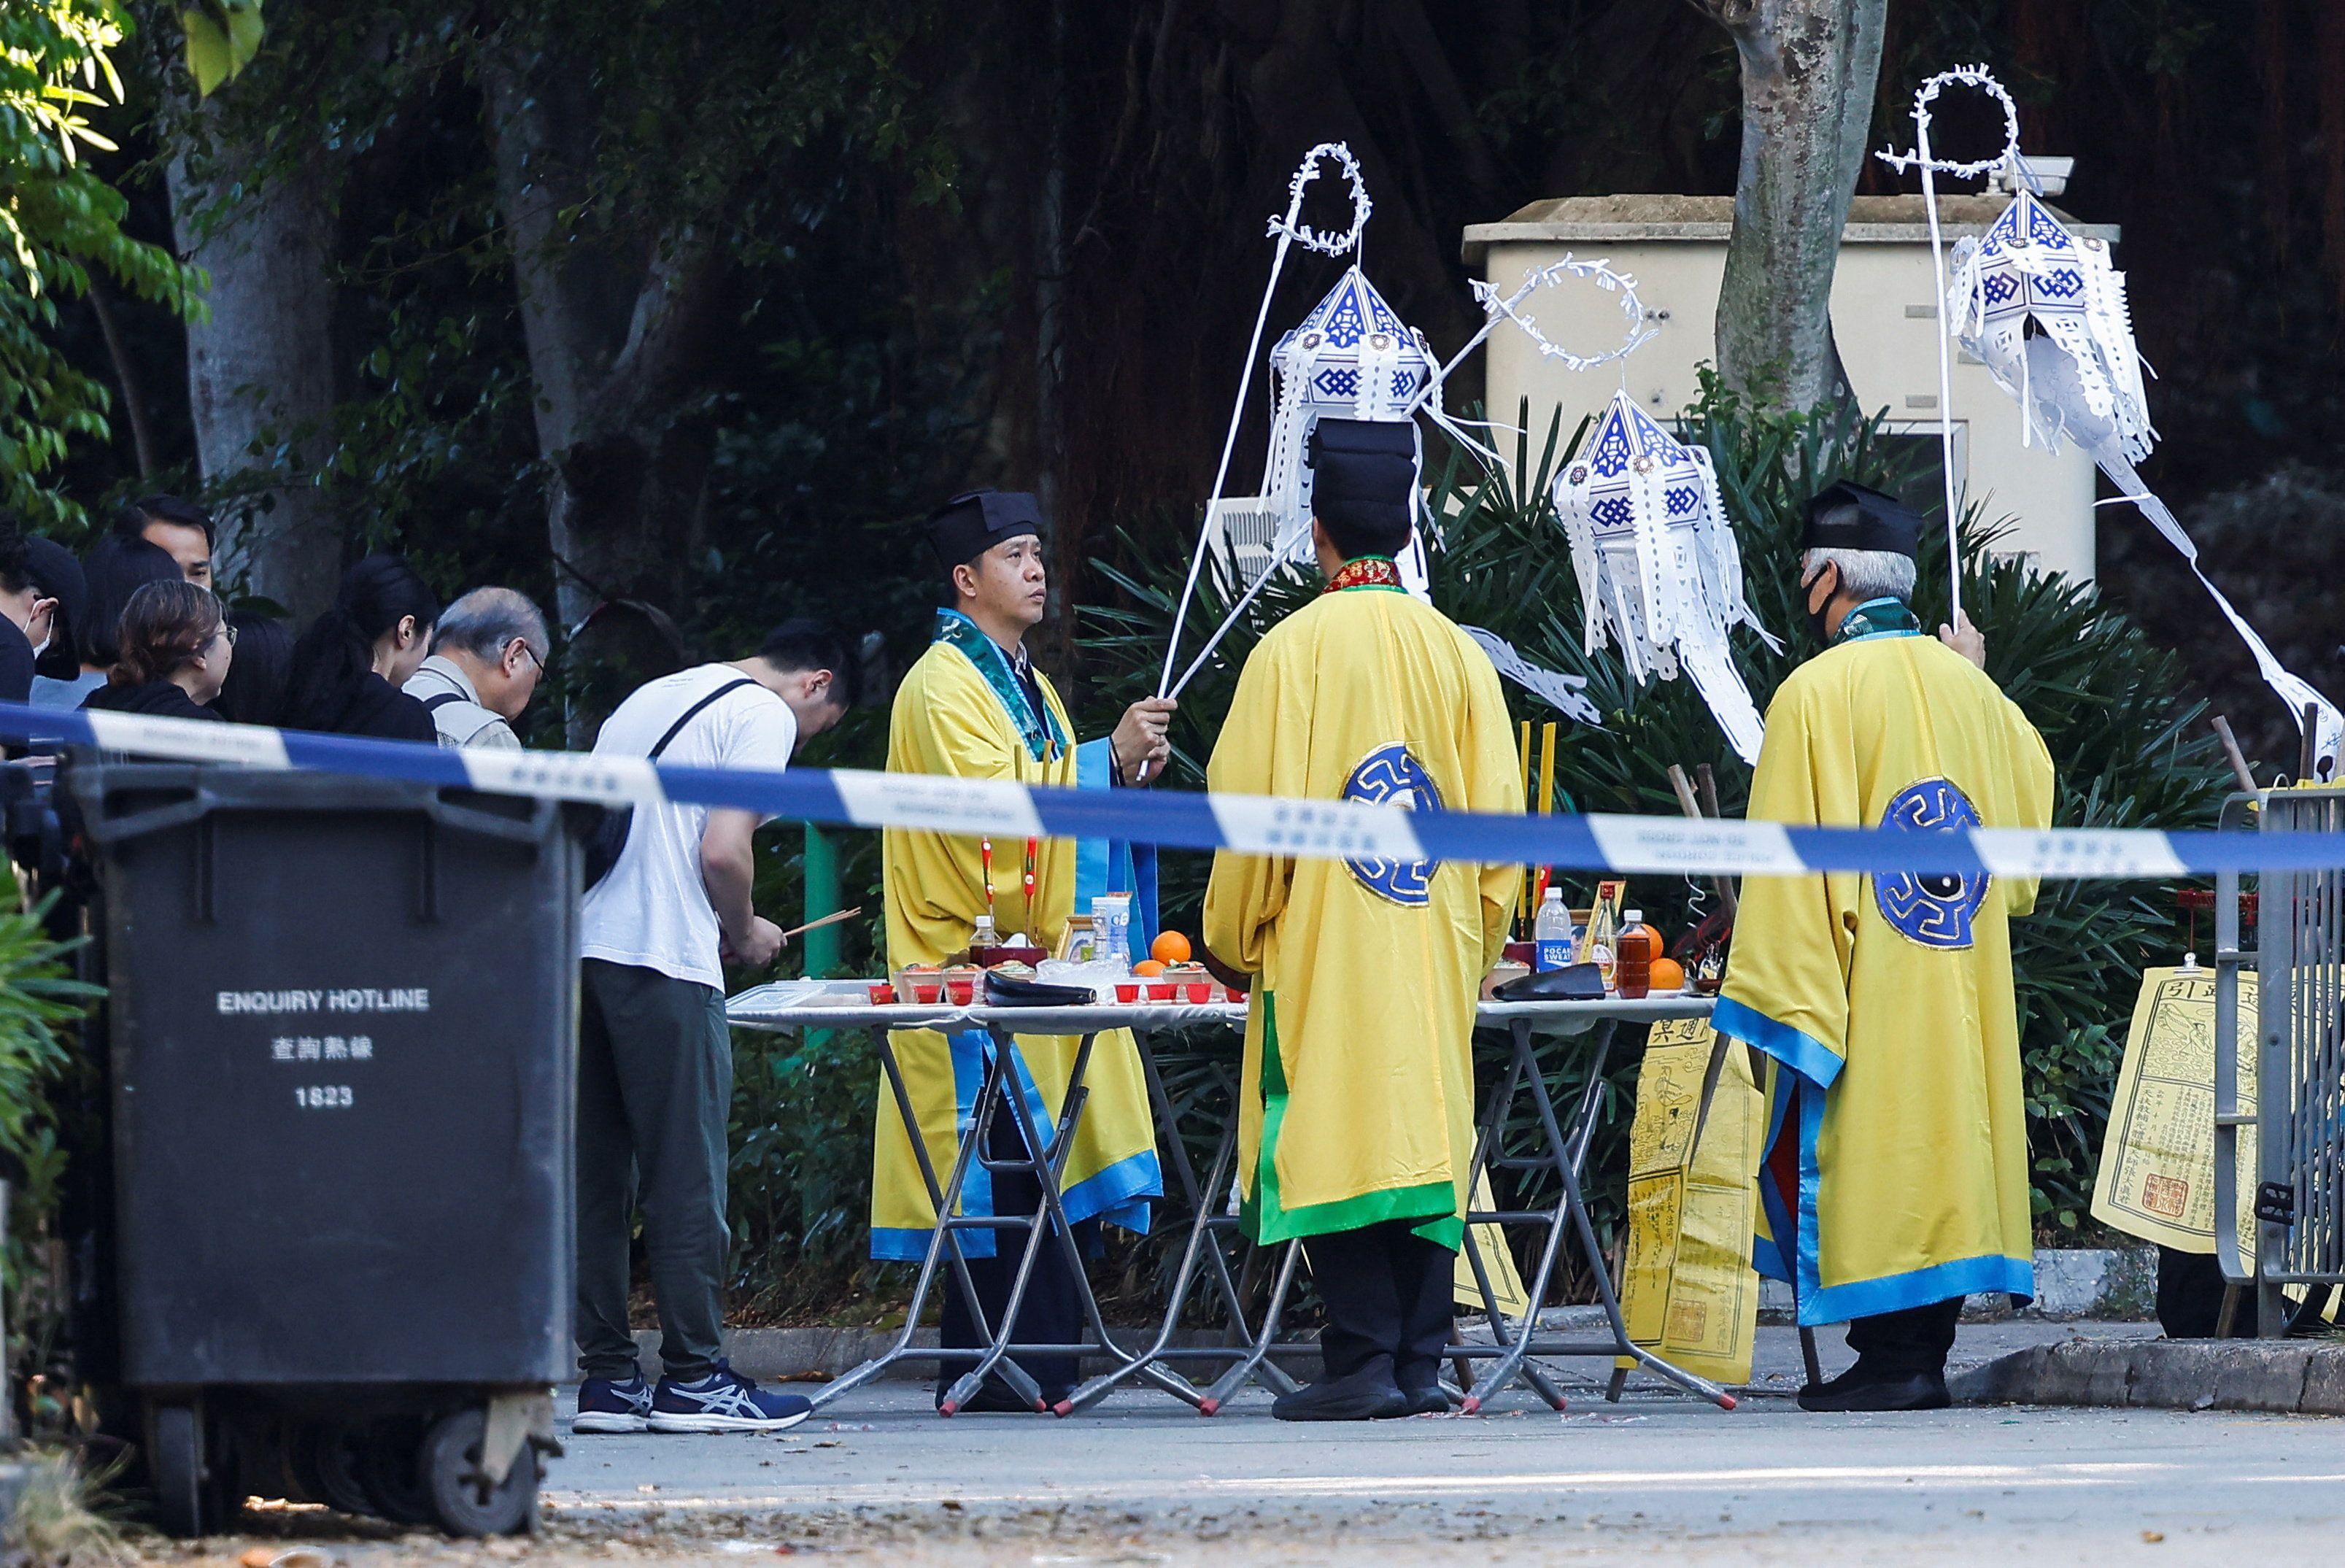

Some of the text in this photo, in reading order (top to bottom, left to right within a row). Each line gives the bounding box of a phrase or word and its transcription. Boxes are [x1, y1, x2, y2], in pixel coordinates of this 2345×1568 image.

[217, 988, 429, 1013] ENQUIRY HOTLINE
[272, 1036, 373, 1060] 查詢熱線
[295, 1086, 353, 1108] 1823
